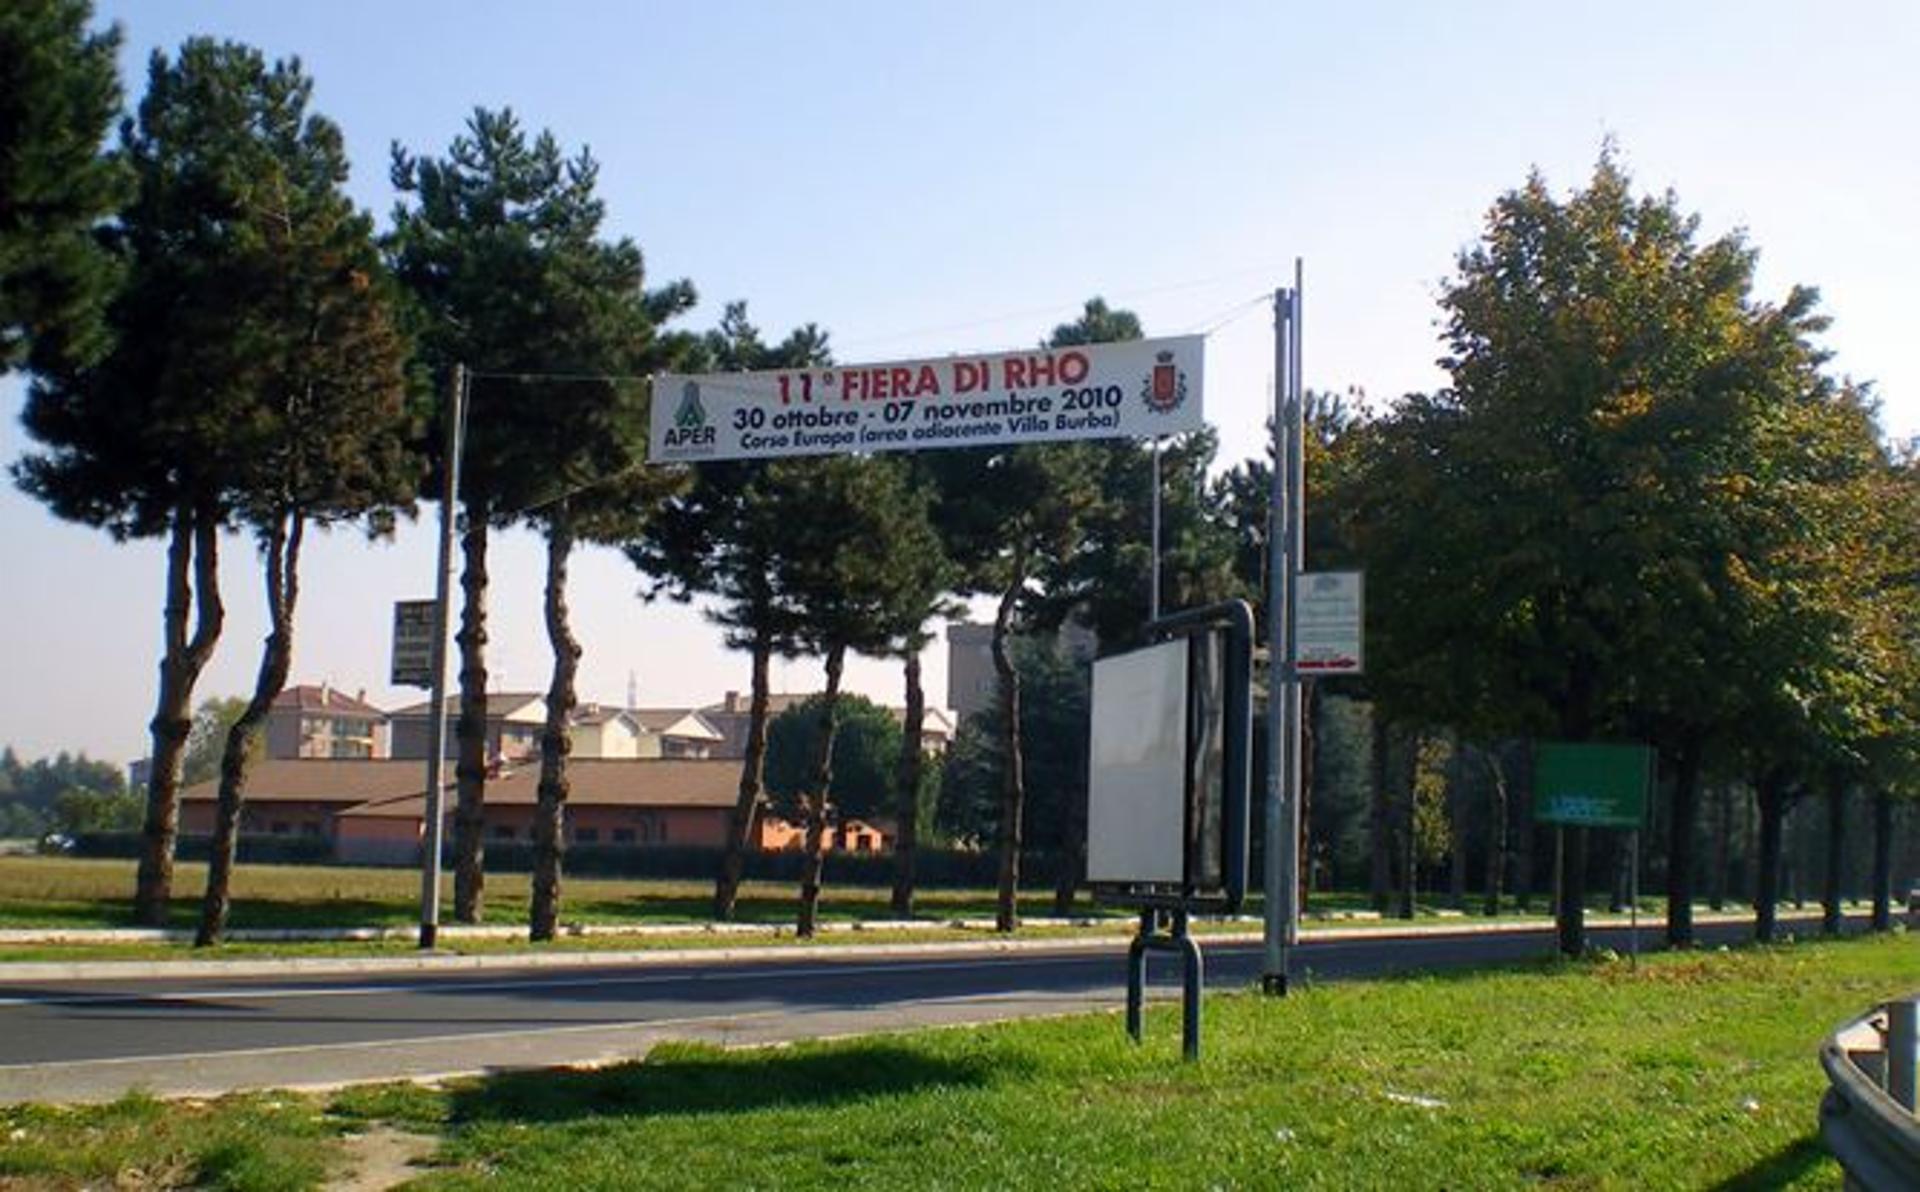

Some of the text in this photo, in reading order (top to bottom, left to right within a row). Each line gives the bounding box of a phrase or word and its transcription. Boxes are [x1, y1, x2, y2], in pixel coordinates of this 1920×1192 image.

[842, 365, 940, 401] FIERA
[954, 361, 991, 393] DI
[1004, 352, 1090, 389] RHO
[733, 408, 765, 430] 30
[773, 405, 859, 430] ottobre
[883, 400, 916, 423] 07
[924, 393, 1053, 421] novembre
[1061, 385, 1123, 410] 2010
[740, 408, 1121, 450] Corso Europa (area adiacente Villa Burba)
[664, 426, 717, 447] APER
